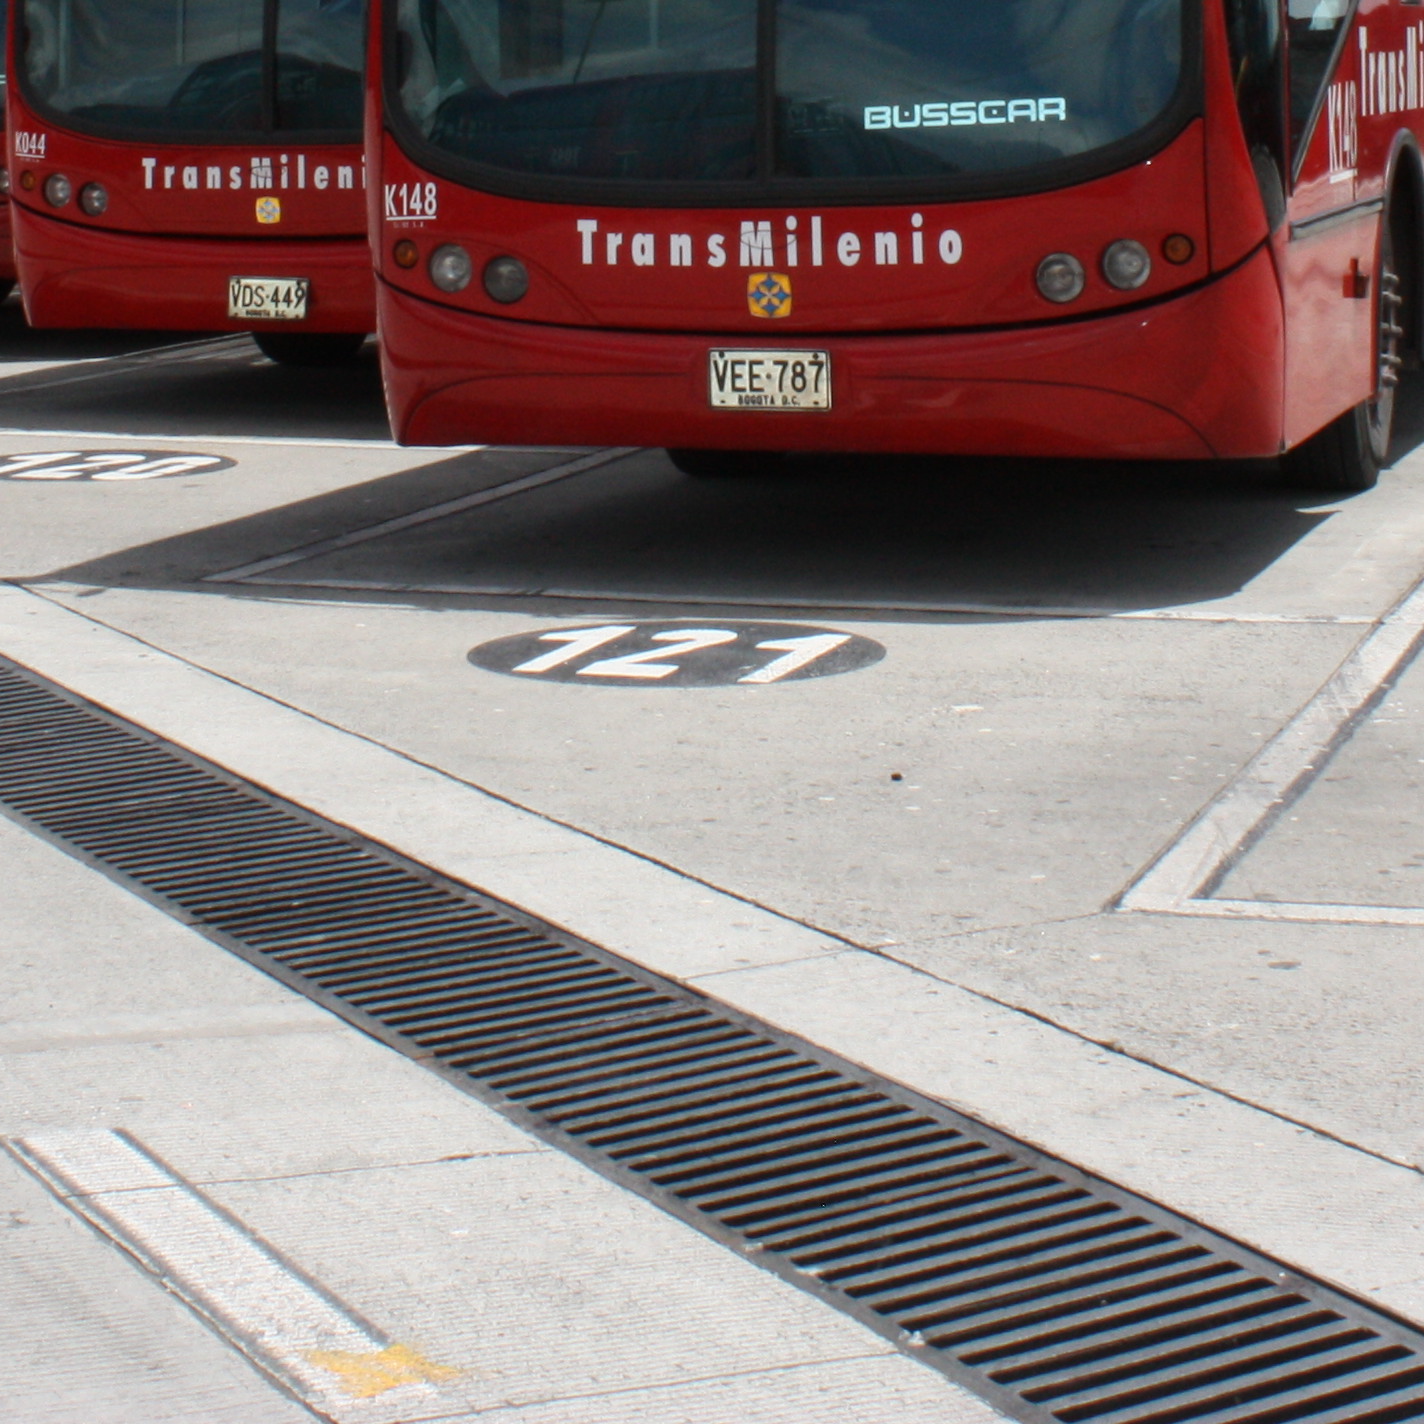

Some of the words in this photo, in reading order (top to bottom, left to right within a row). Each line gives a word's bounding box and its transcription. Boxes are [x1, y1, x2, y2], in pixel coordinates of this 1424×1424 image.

[864, 97, 1066, 130] BUSSCAR
[15, 131, 47, 154] K044
[384, 182, 437, 217] K148
[576, 212, 963, 268] TransMilenio
[512, 624, 854, 684] 121
